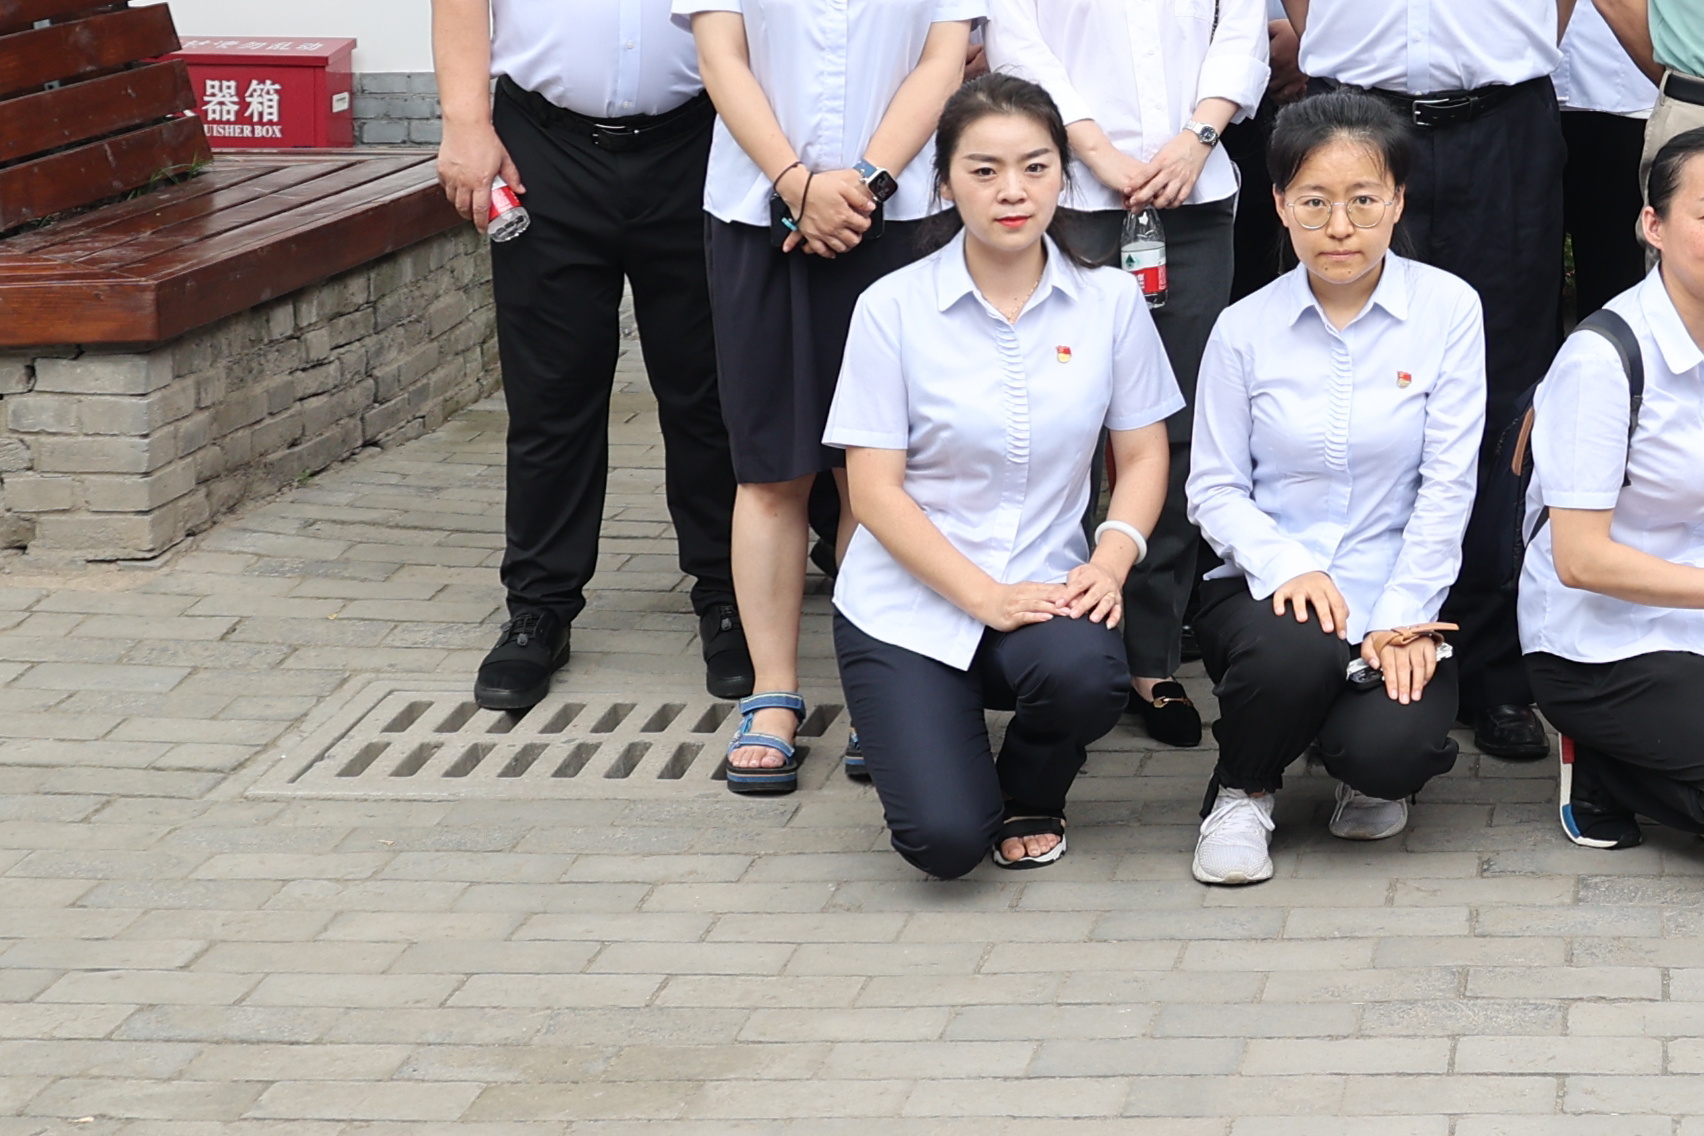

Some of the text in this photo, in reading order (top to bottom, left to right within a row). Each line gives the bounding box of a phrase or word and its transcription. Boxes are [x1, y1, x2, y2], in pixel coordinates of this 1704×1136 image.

[183, 79, 282, 123] 器箱
[203, 124, 282, 138] UISHER BOX
